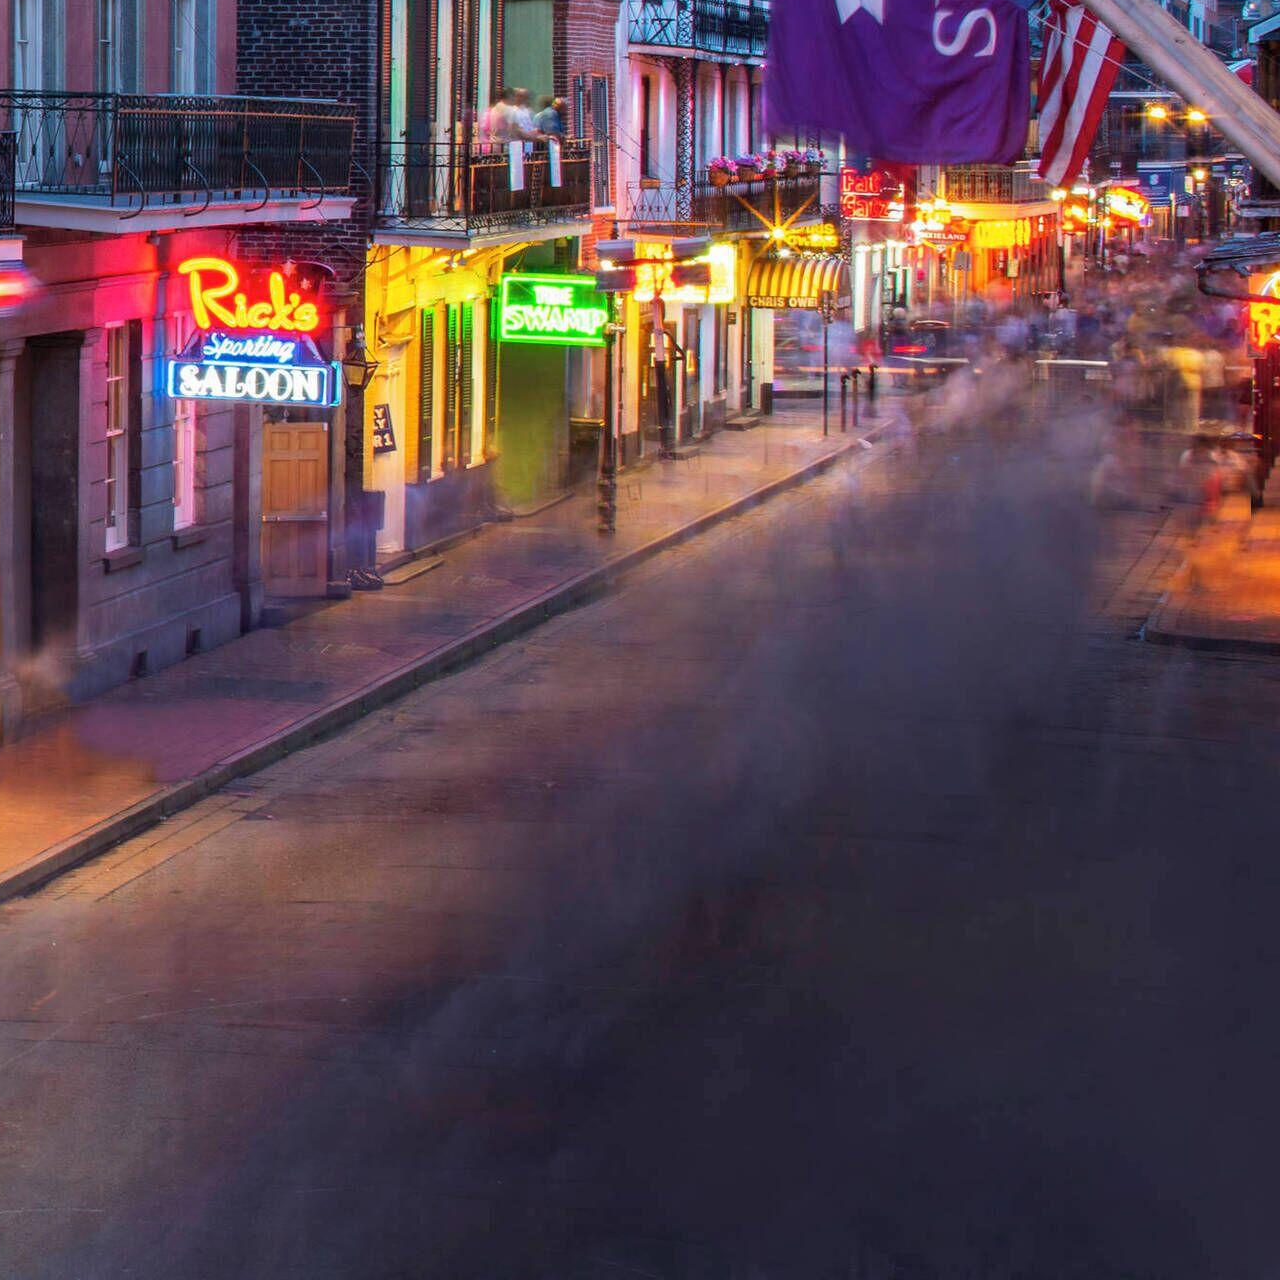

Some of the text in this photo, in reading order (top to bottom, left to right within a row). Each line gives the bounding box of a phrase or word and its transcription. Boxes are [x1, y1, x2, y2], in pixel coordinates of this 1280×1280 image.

[178, 257, 319, 331] Rick's
[533, 285, 573, 306] THE
[750, 296, 785, 307] CHRIS
[504, 306, 608, 334] SWAMP
[203, 332, 296, 362] Sporting
[179, 364, 320, 401] SALOON
